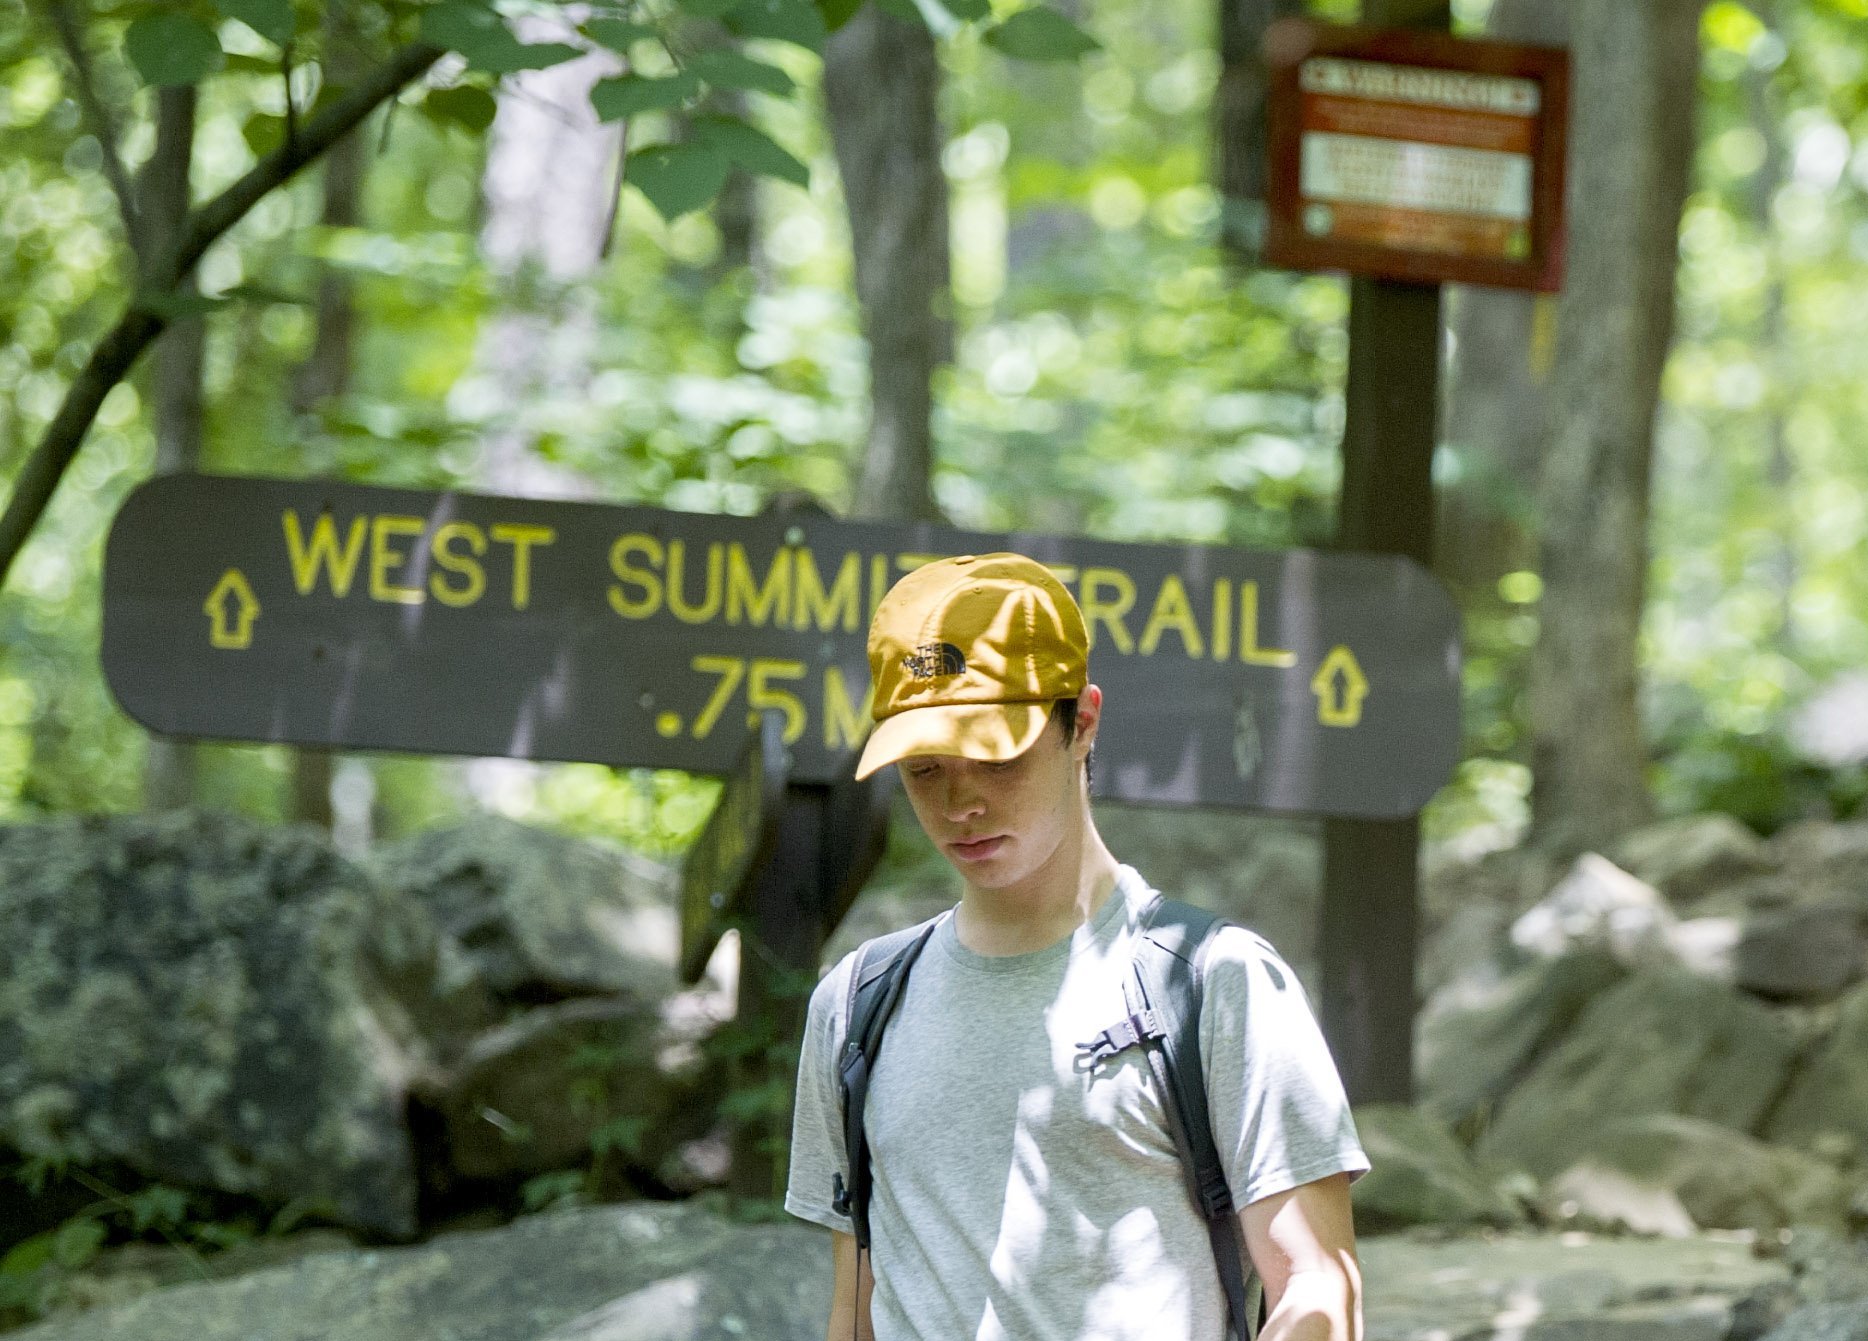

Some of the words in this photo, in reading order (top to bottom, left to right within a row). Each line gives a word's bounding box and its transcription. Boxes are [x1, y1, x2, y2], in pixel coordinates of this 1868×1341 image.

[282, 508, 556, 610] WEST
[1050, 564, 1297, 668] RAIL
[917, 642, 942, 655] THE
[655, 655, 808, 746] .75
